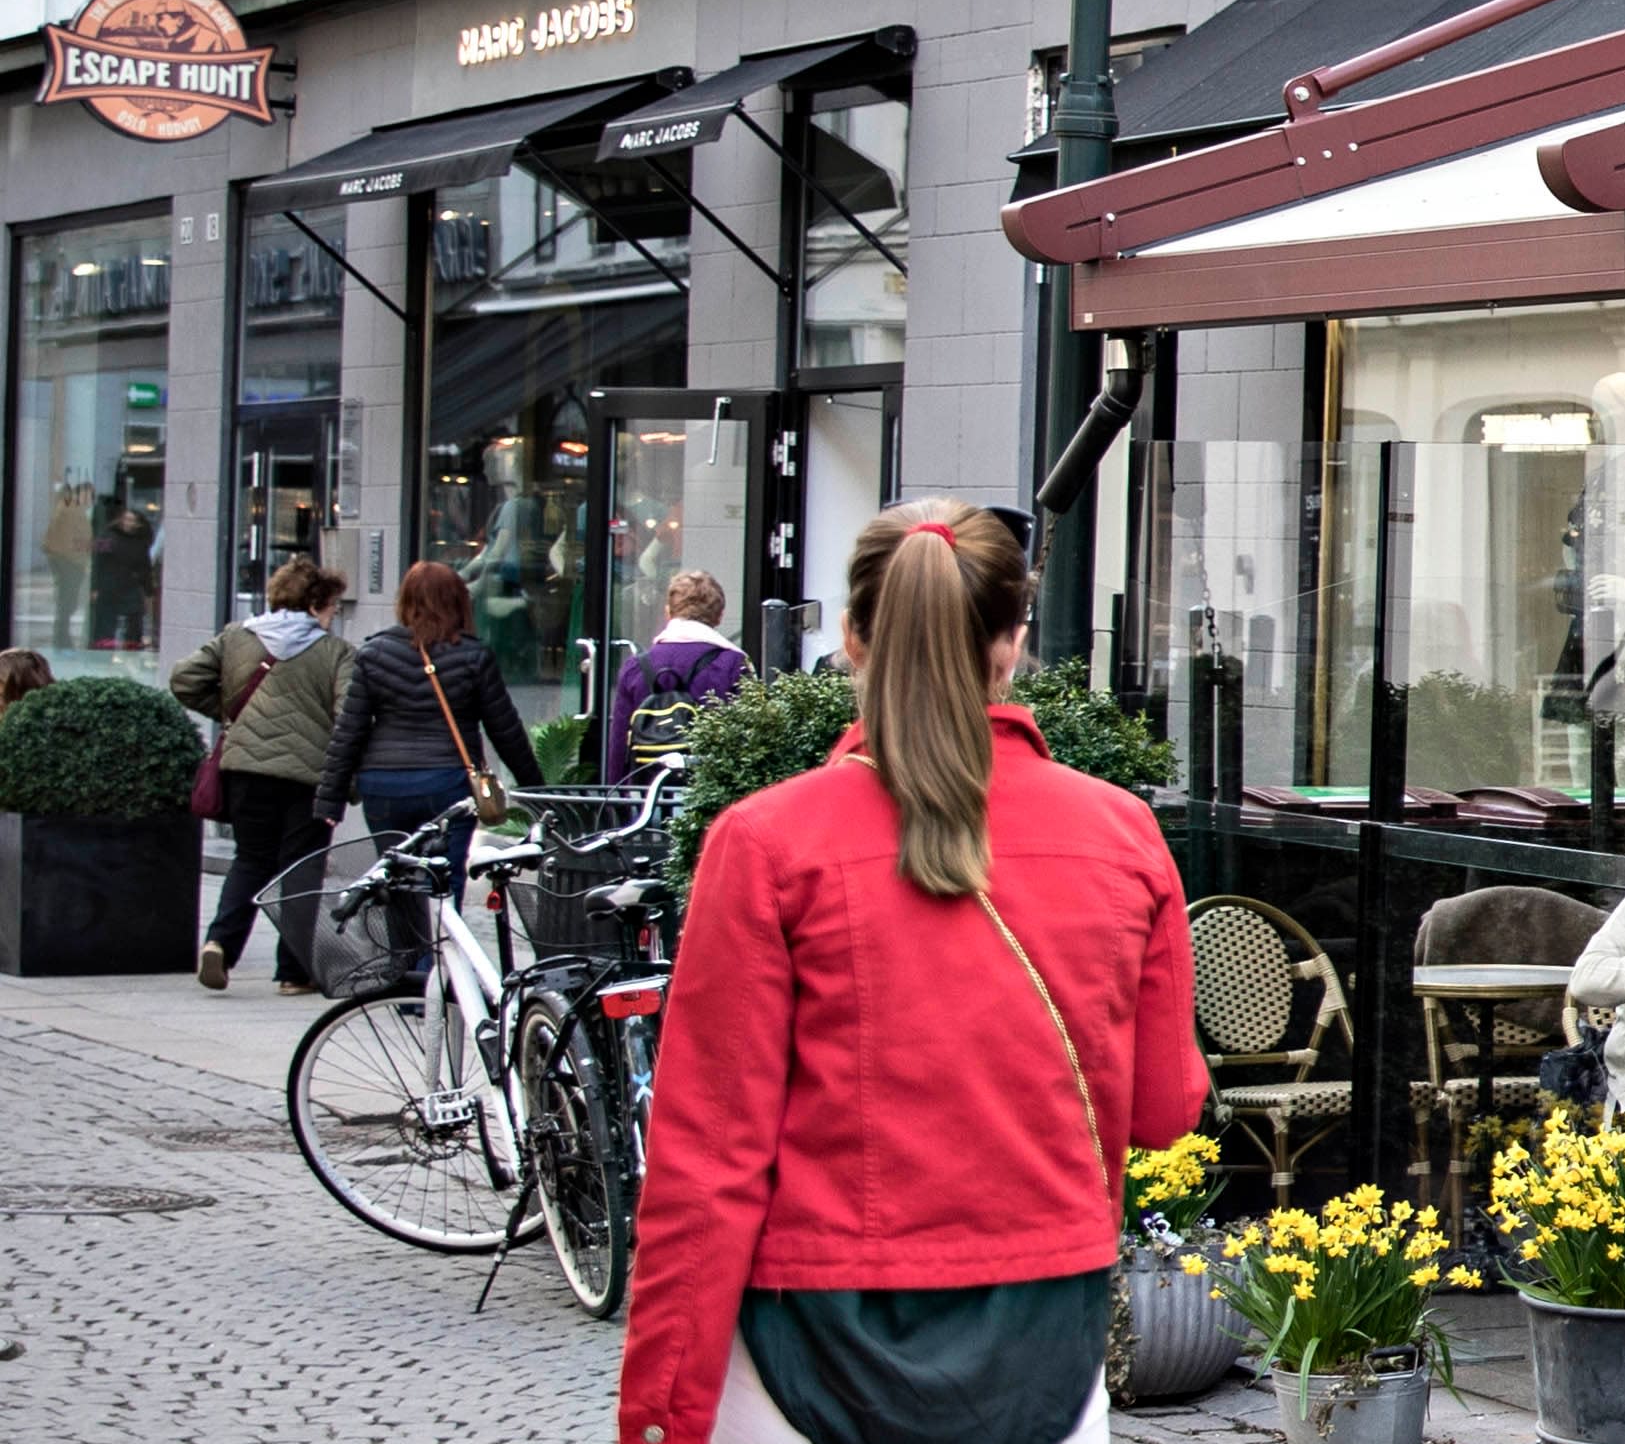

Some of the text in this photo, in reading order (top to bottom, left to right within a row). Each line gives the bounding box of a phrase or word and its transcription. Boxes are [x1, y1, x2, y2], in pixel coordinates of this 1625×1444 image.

[459, 17, 525, 65] MARC
[66, 47, 257, 100] ESCAPE HUNT
[620, 121, 701, 149] MARC JACOBS
[340, 173, 402, 195] MARC JACOBS
